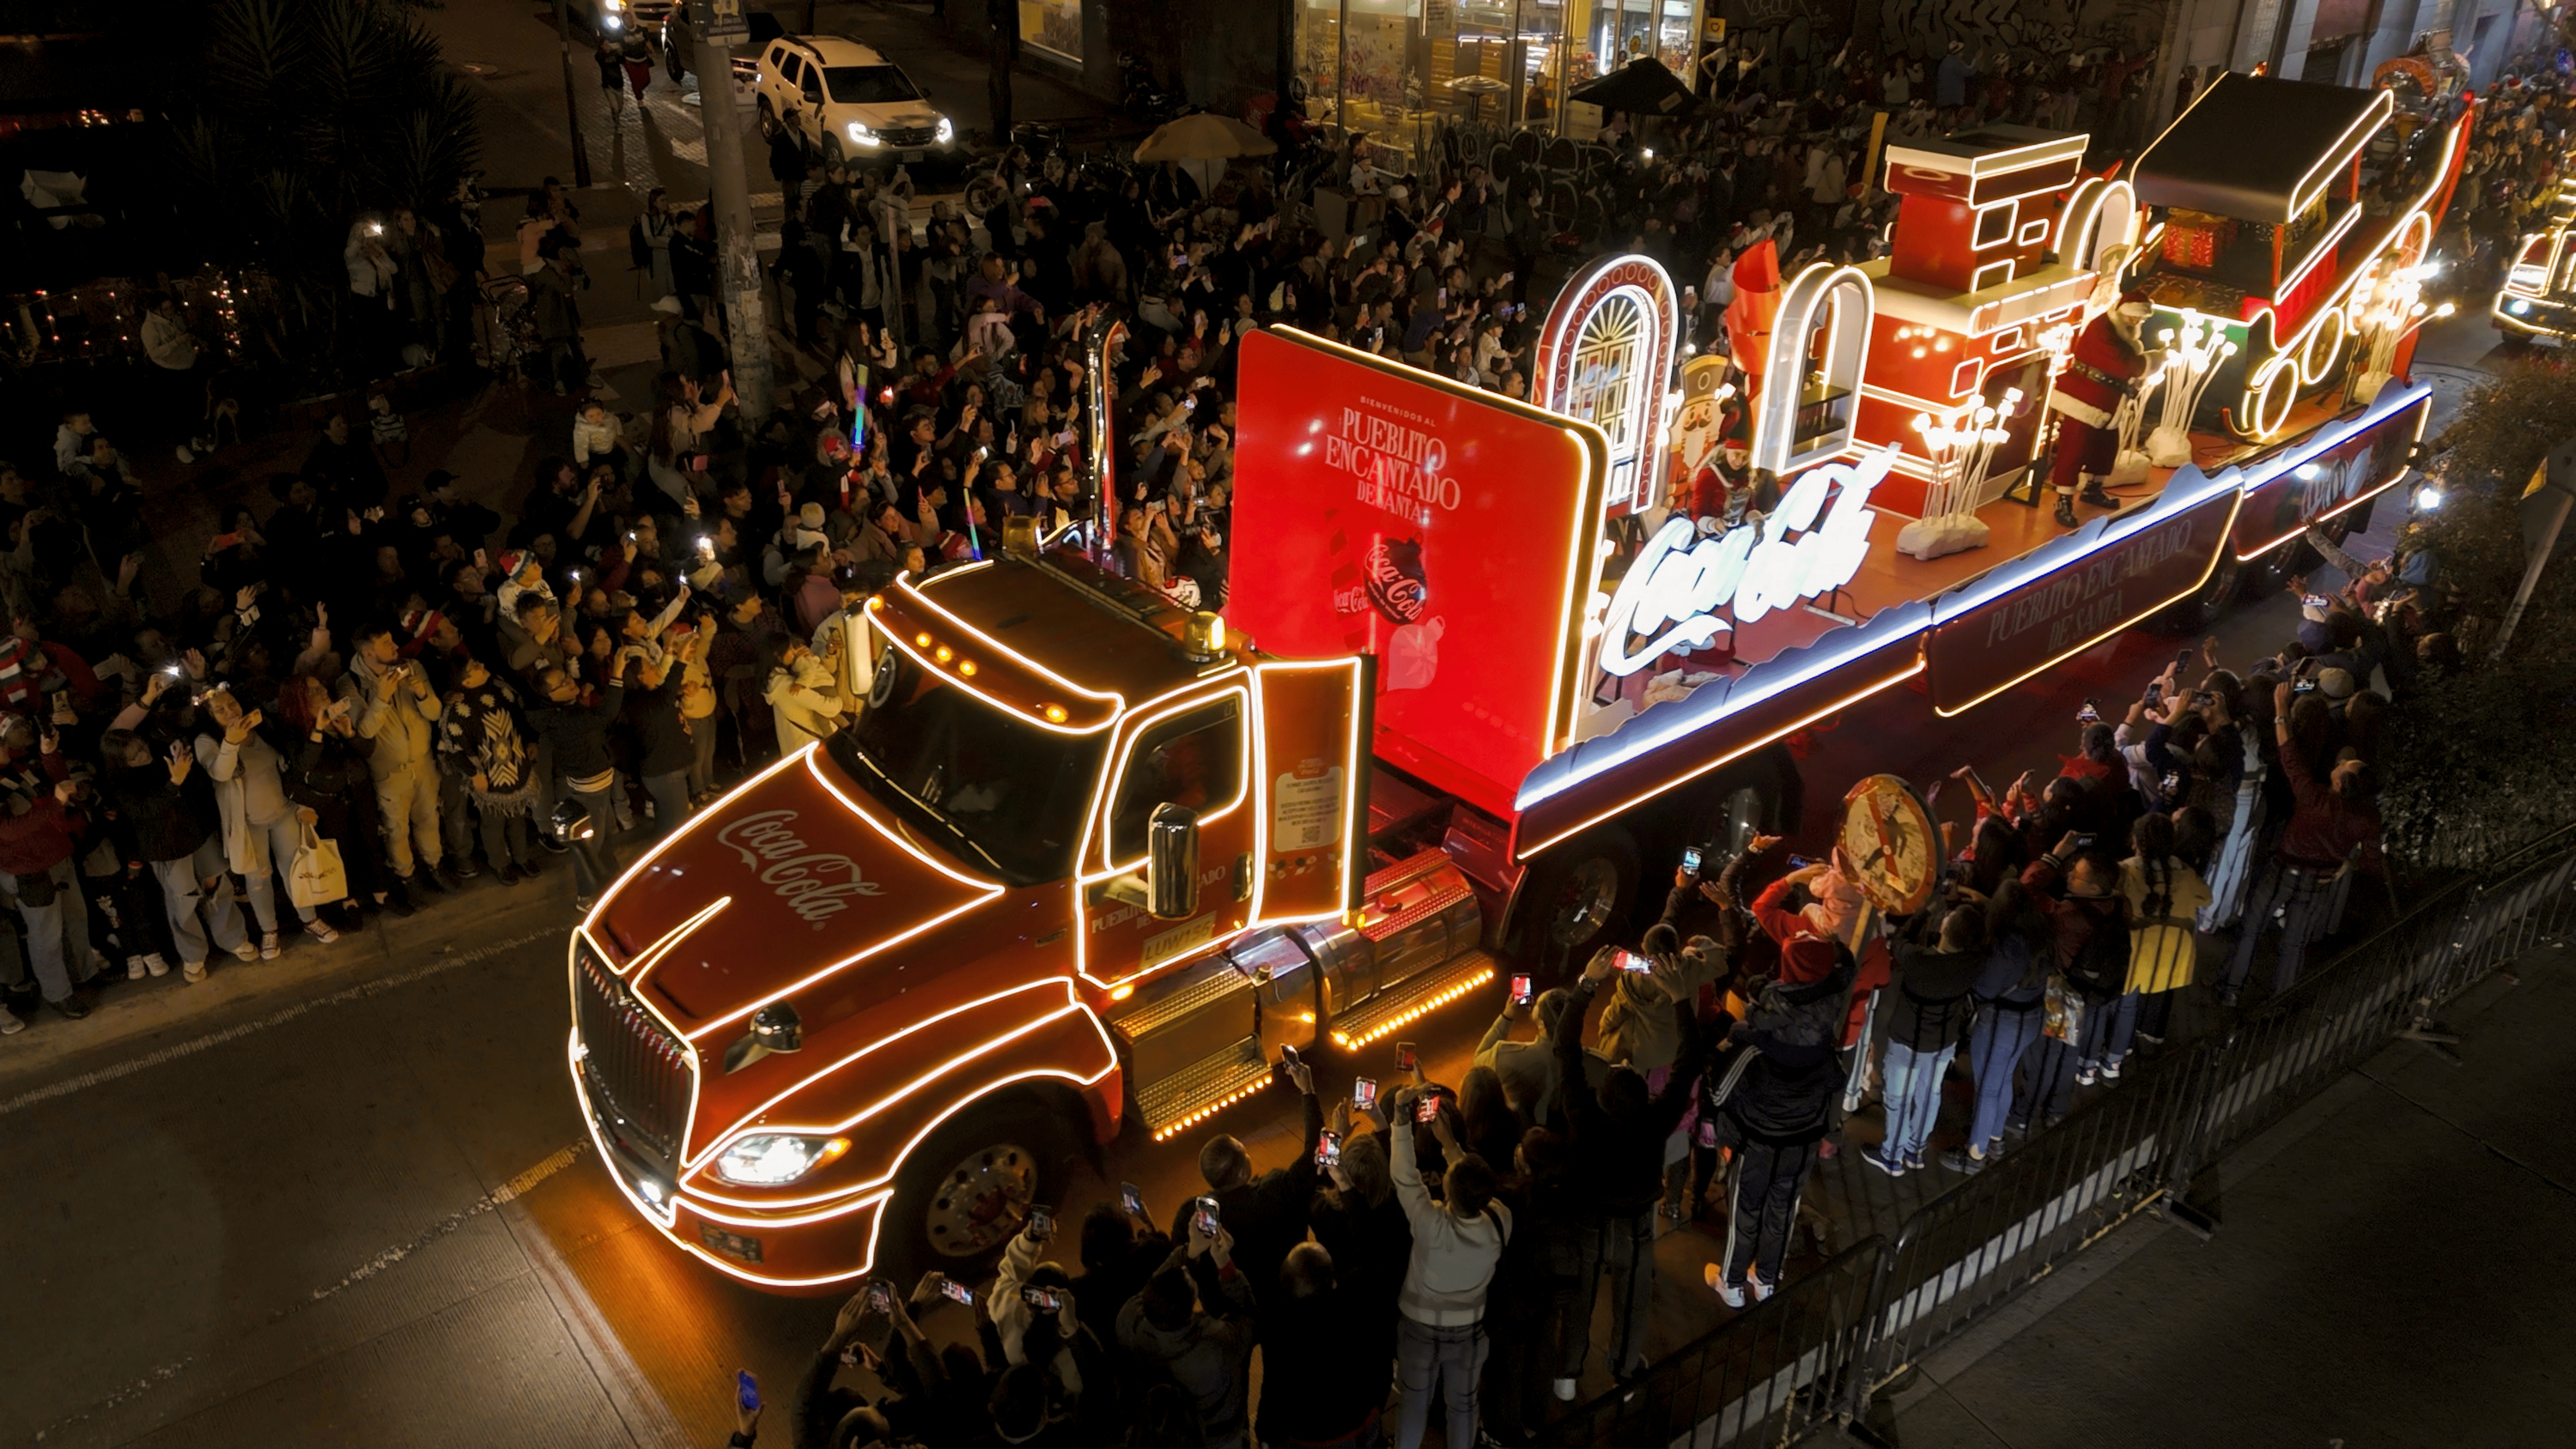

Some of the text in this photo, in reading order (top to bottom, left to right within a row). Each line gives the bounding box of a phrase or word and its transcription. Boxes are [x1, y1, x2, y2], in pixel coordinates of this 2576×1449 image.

[1342, 407, 1447, 471] PUEBLITO
[1360, 395, 1437, 427] BIENVENIDOS AL
[1325, 435, 1461, 511] ENCANTADO
[1357, 479, 1376, 505] DE
[1987, 518, 2192, 648] PUEBLITO ENCANTADO
[2049, 592, 2123, 651] DE SANTA
